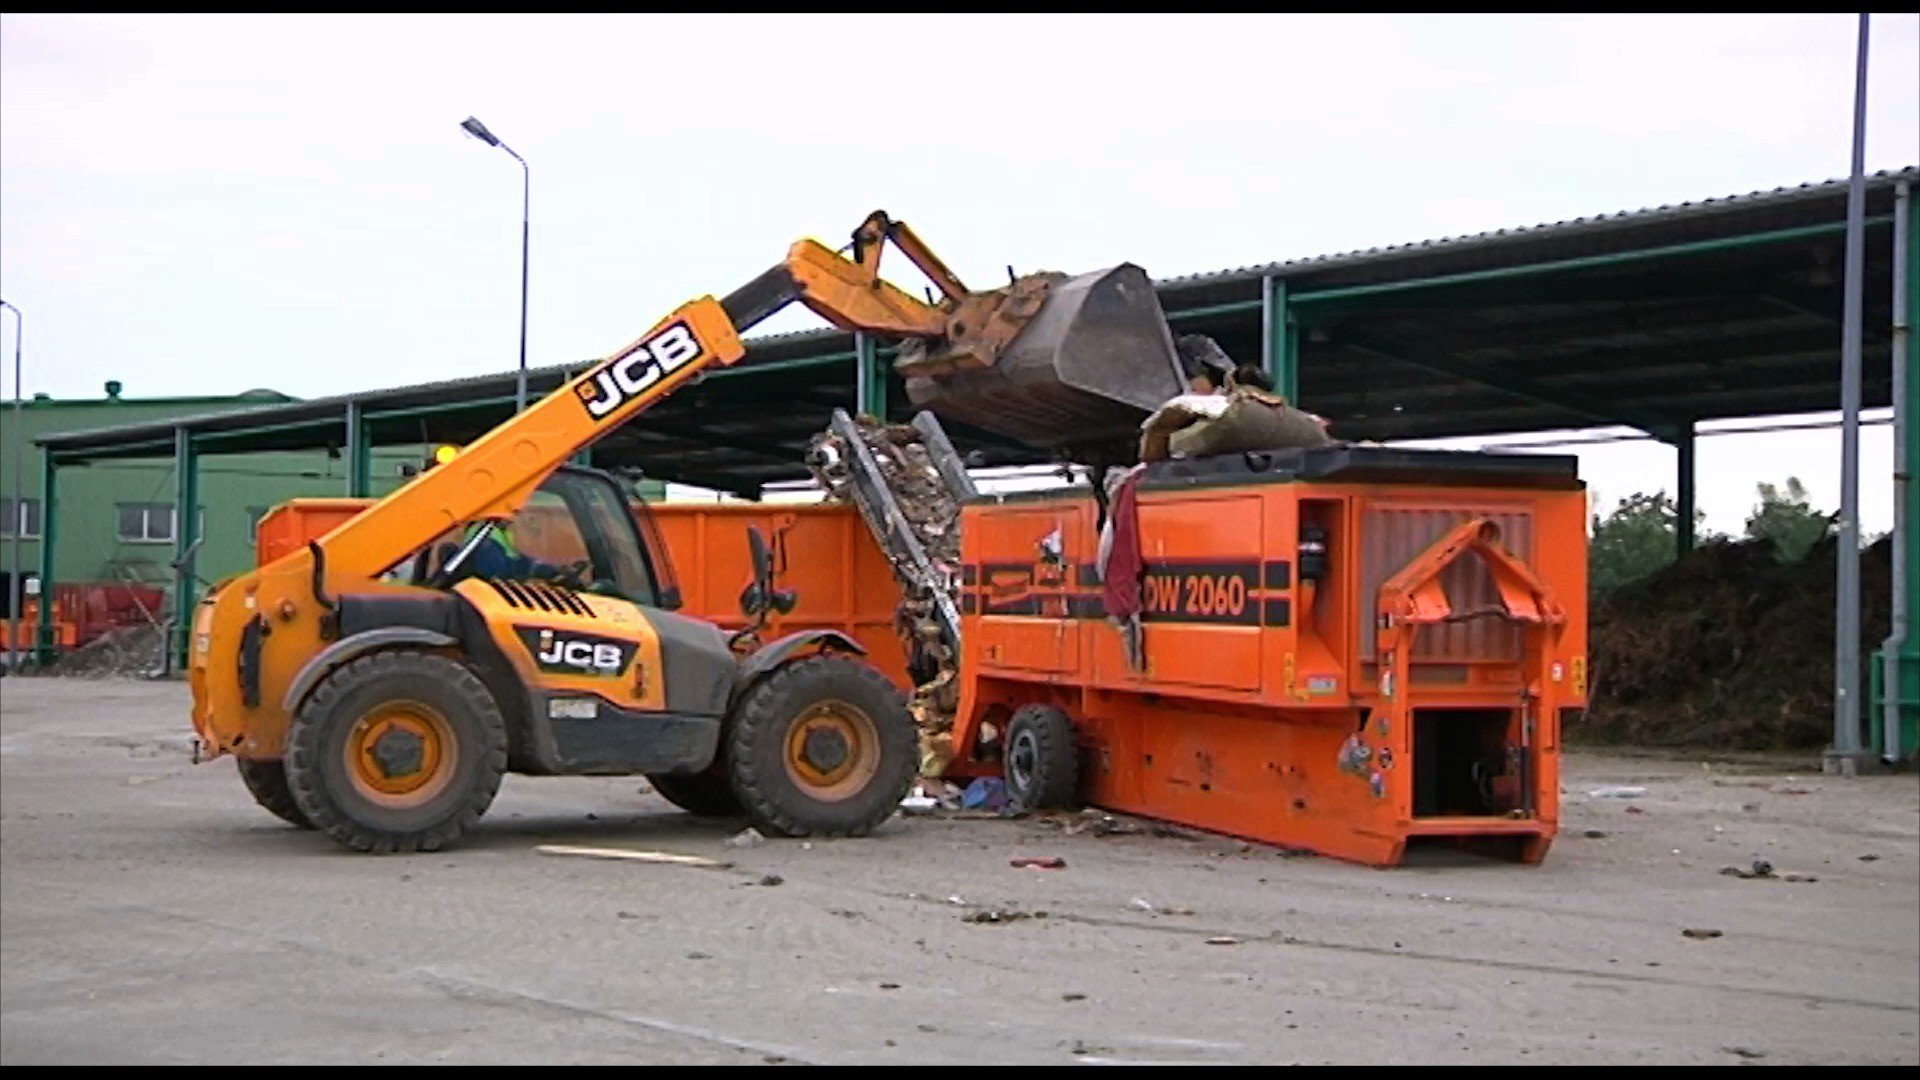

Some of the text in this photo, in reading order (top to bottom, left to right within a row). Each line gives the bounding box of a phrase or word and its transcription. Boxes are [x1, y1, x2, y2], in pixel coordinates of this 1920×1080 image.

[588, 325, 700, 416] JCB
[1143, 575, 1245, 615] DW 2060
[539, 640, 622, 668] JCB
